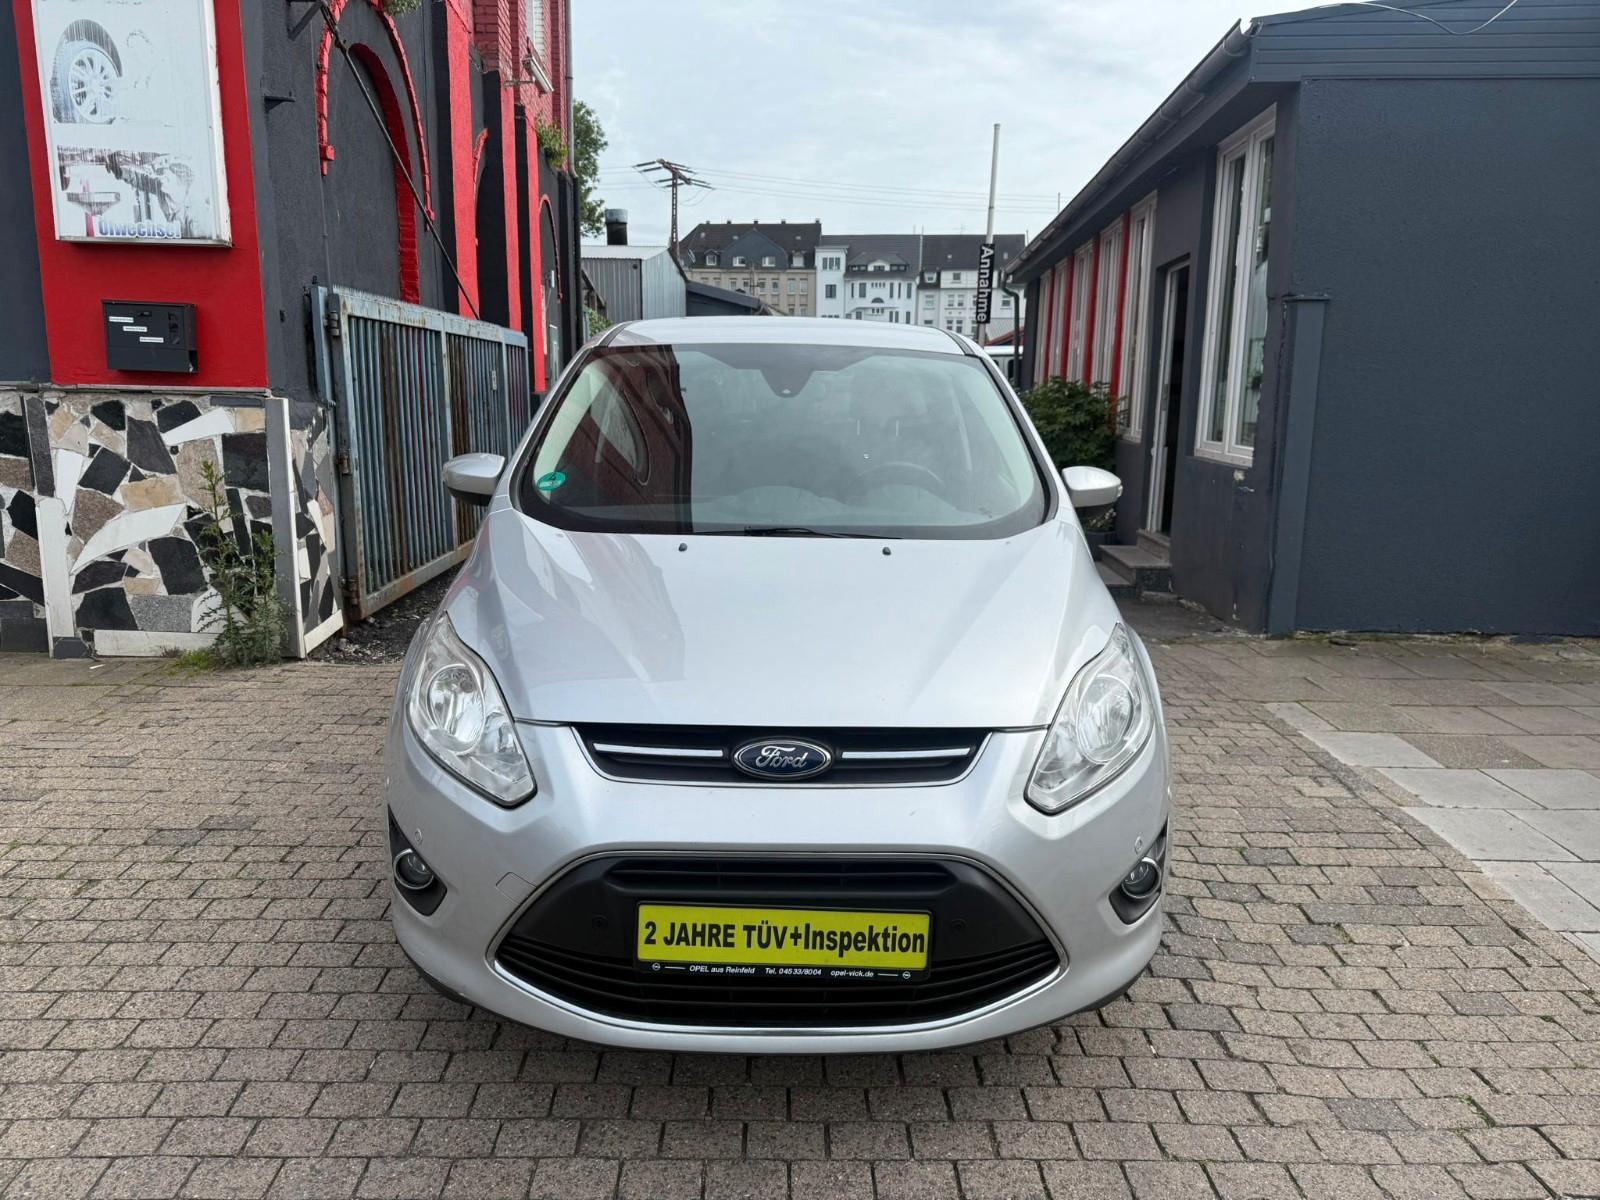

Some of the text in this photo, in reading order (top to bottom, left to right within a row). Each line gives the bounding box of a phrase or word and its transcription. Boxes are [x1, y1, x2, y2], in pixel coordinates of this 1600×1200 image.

[977, 246, 994, 322] Annahme
[755, 745, 808, 768] Ford
[643, 920, 657, 945] 2
[663, 922, 736, 948] JAHRE
[689, 965, 709, 973] OPEL
[725, 966, 756, 974] Reinfeld
[765, 967, 777, 975] Tel.
[830, 969, 875, 978] opel-vick.de
